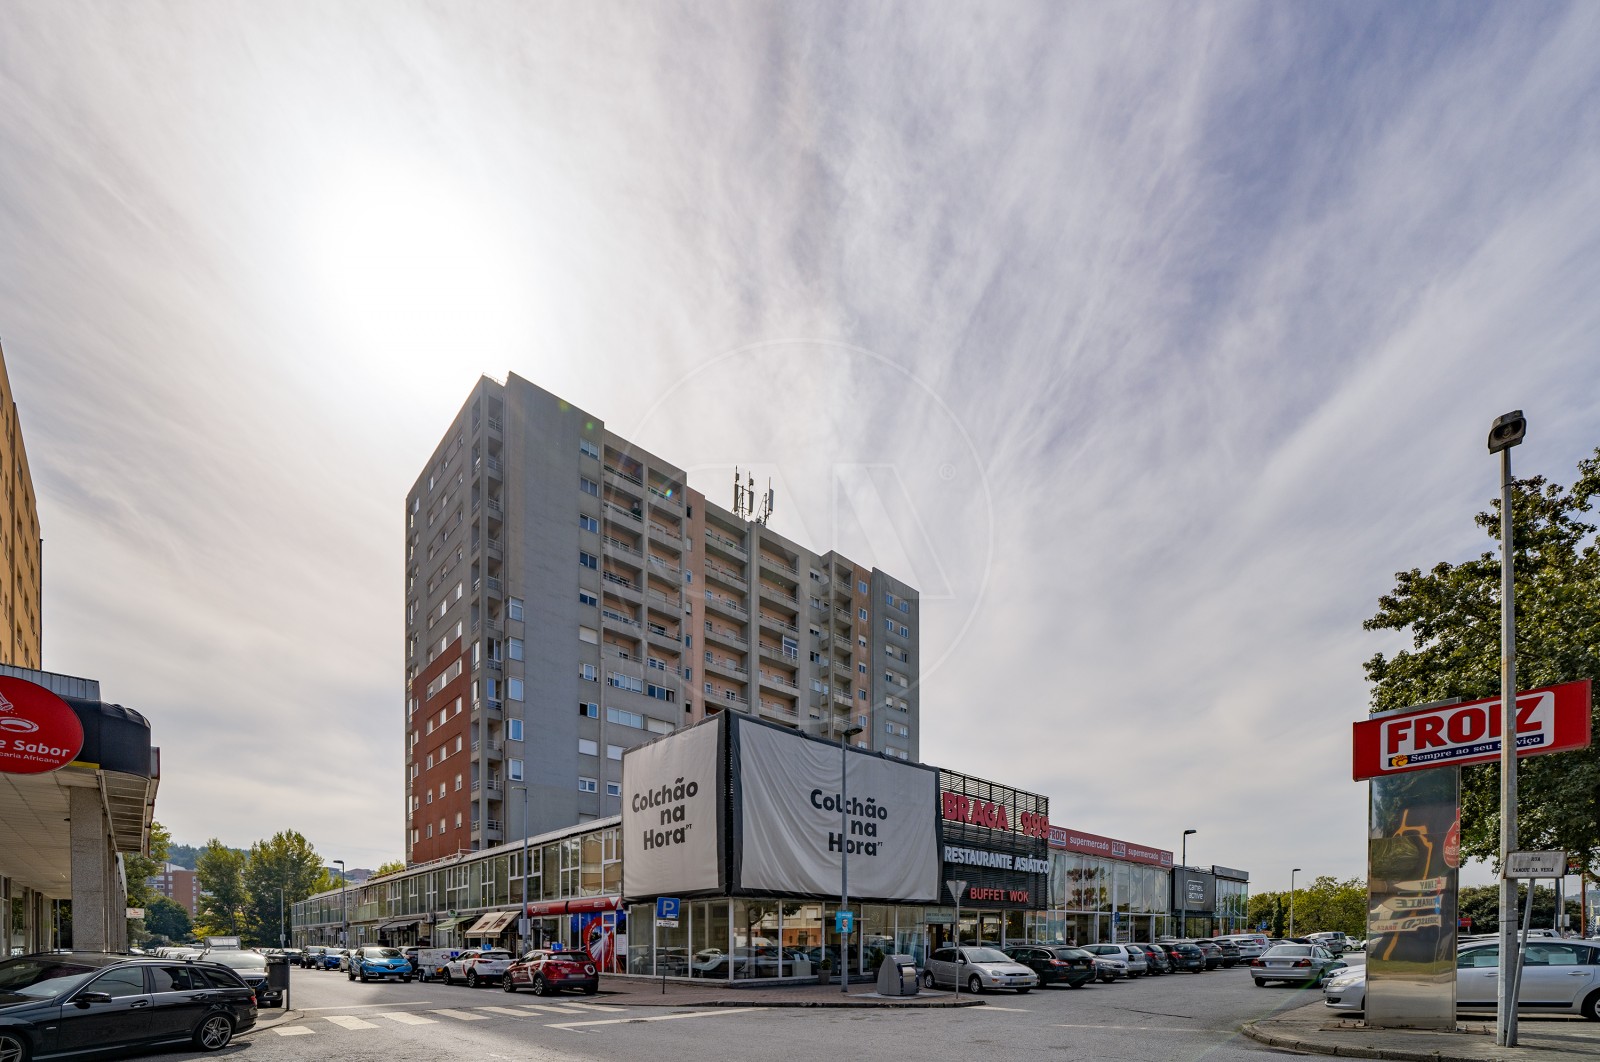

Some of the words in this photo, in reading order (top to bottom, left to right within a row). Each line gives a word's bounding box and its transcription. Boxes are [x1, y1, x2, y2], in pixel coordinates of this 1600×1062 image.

[1387, 695, 1545, 755] FROIZ
[13, 740, 70, 757] Sabor
[23, 754, 60, 764] Africana
[1411, 750, 1452, 762] Sempre
[1473, 744, 1493, 753] seu
[1497, 737, 1541, 749] sviço
[632, 776, 699, 813] Colchão
[810, 788, 888, 820] Colchão
[660, 804, 686, 826] na
[943, 791, 1009, 832] BRAGA
[1020, 810, 1050, 839] 999
[643, 827, 686, 851] Hora
[851, 819, 877, 838] na
[944, 845, 1013, 870] RESTAURANTE
[1014, 854, 1050, 874] ASIÁTICO
[1069, 836, 1110, 851] supermercado
[1128, 848, 1159, 860] supermercado
[970, 887, 1005, 901] BUFFET
[1009, 890, 1029, 902] WOK
[1188, 883, 1204, 892] camel
[1188, 892, 1204, 900] active
[662, 900, 675, 916] P
